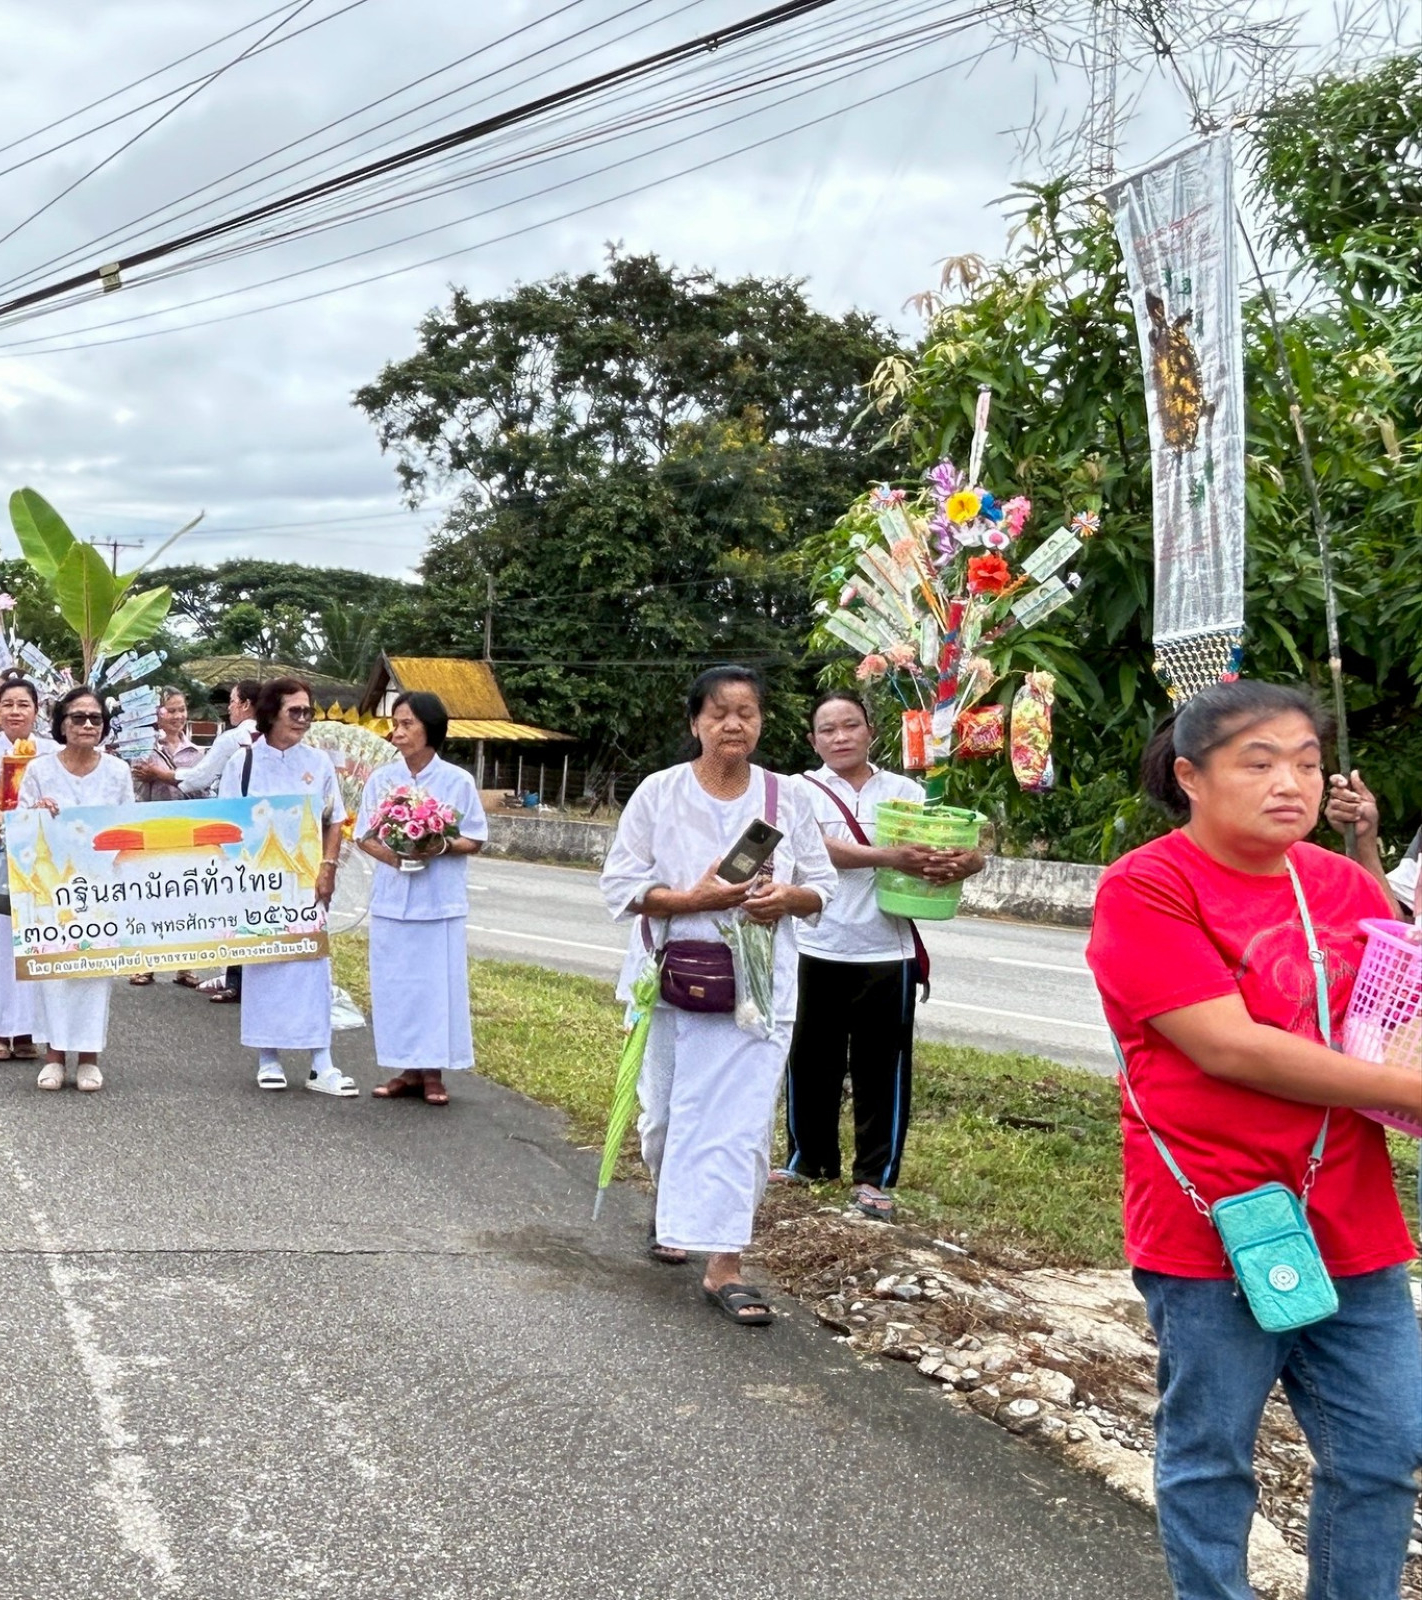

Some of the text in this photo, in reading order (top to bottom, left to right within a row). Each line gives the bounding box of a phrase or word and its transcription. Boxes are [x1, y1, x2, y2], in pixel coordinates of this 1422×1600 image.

[55, 859, 283, 914] กฐินสามัคคีทั่วไทย
[24, 903, 318, 945] ๓๐,๐๐๐ วัด พุทธศักราช ๒๕๖๘
